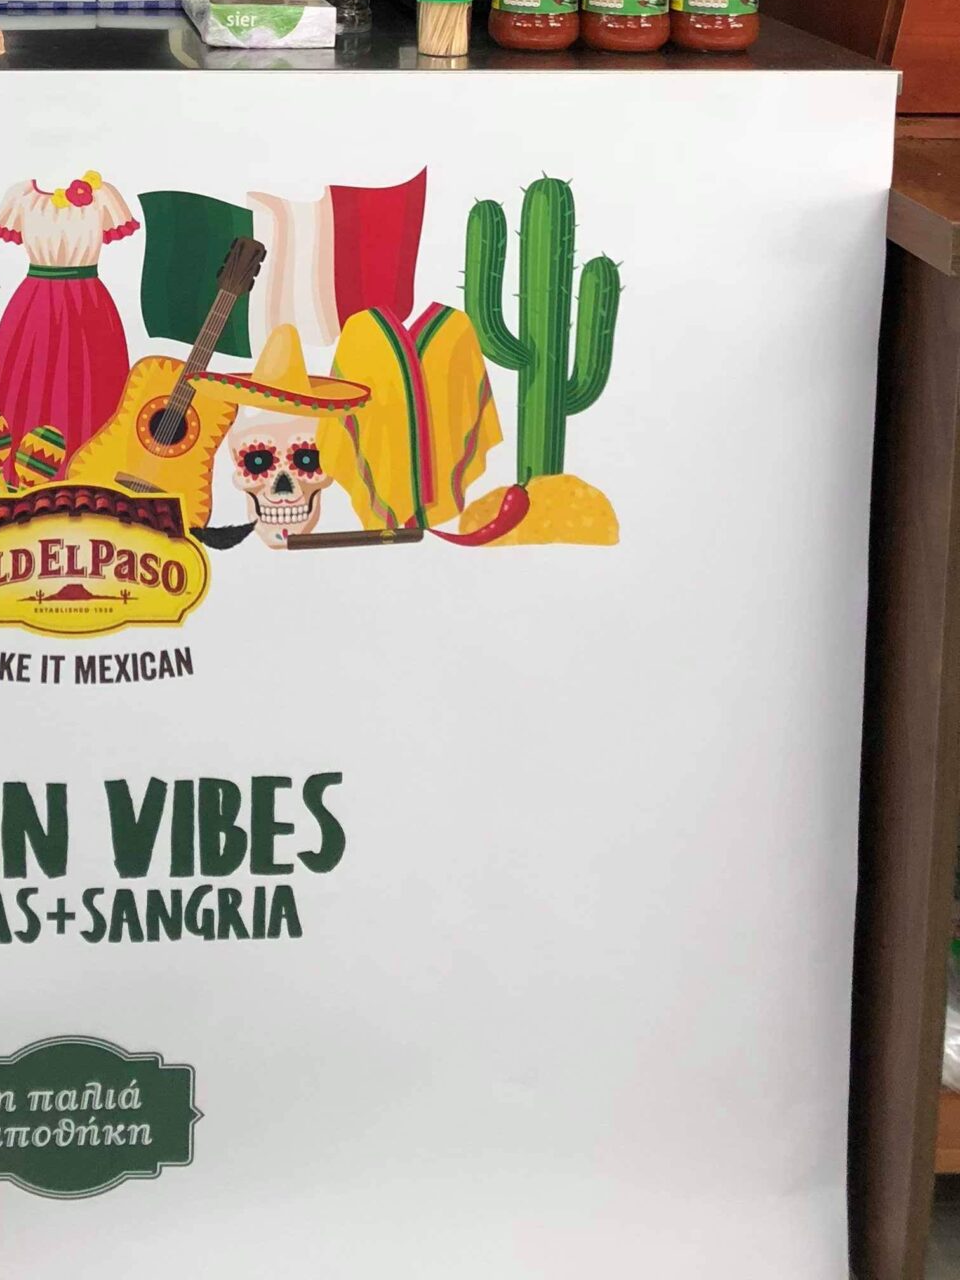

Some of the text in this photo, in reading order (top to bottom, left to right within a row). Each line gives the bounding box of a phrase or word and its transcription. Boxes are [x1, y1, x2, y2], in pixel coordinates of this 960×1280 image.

[227, 11, 258, 27] sier
[37, 538, 88, 580] EL
[41, 655, 65, 684] IT
[74, 646, 195, 685] MEXICAN
[104, 771, 346, 879] VIBES
[27, 1079, 143, 1113] παλιά
